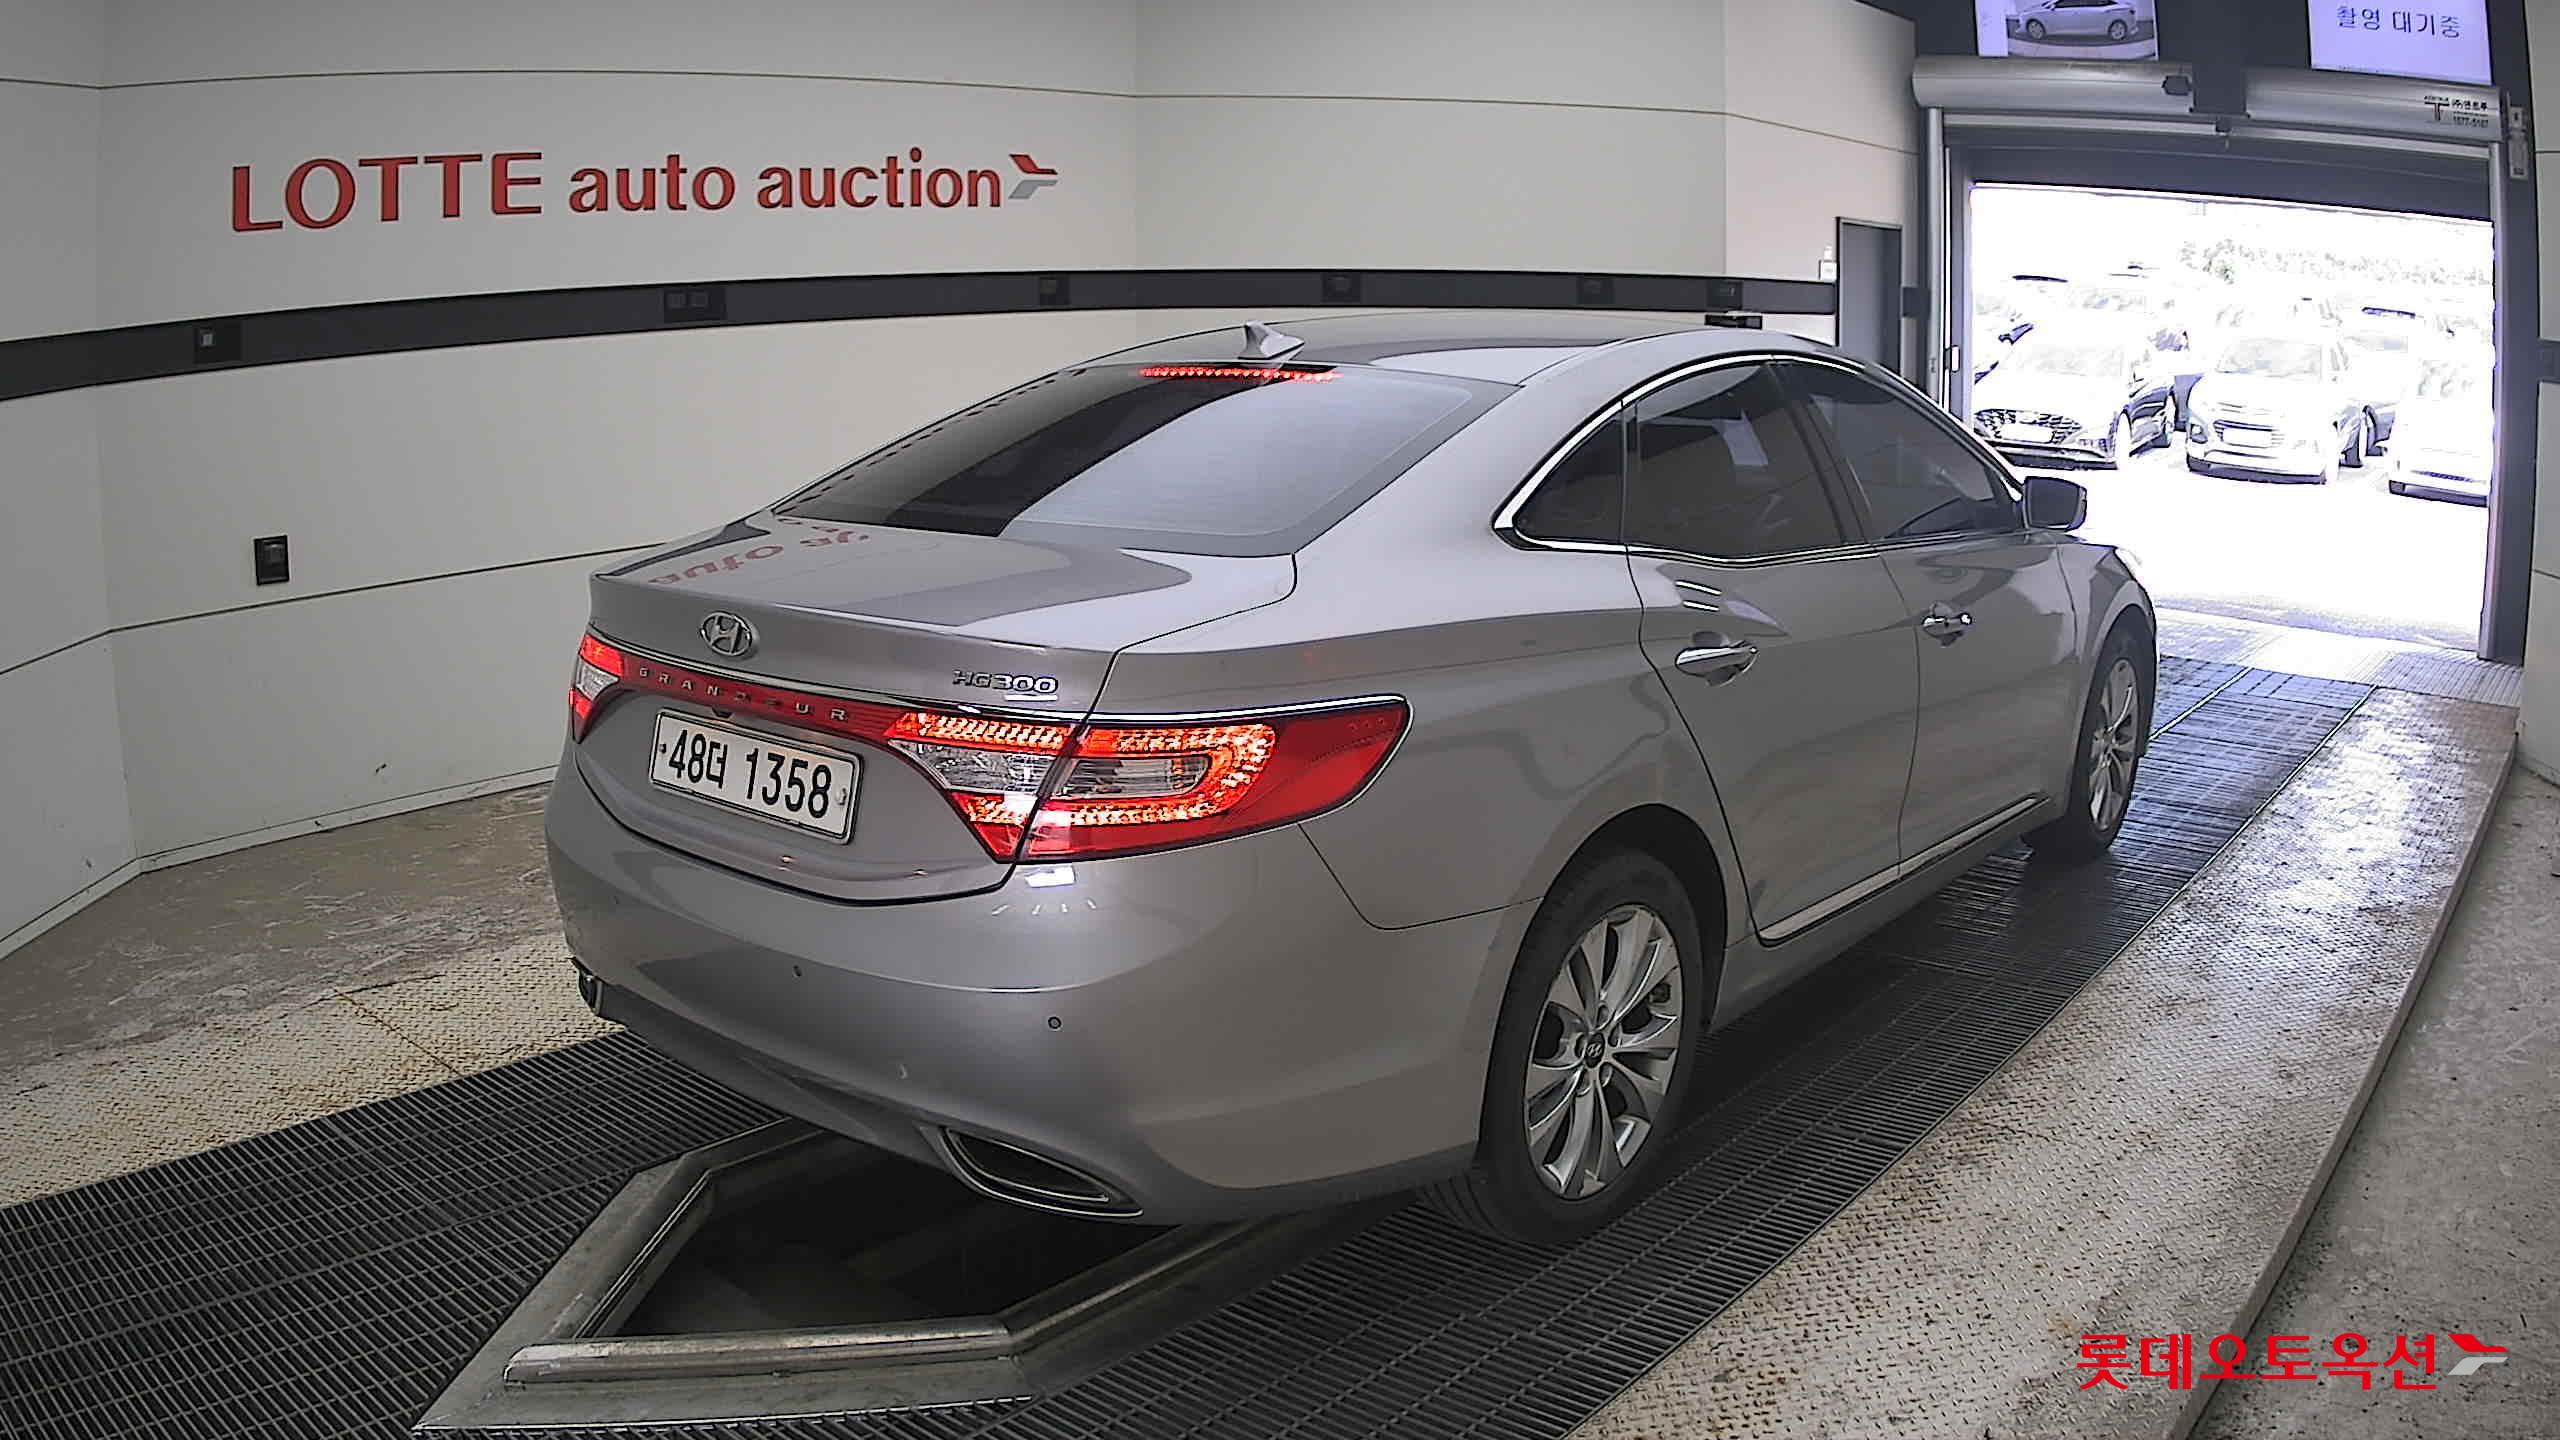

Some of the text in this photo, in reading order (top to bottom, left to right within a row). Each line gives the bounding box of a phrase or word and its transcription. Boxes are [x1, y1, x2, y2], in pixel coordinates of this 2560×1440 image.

[2337, 6, 2461, 39] 촬영 대기중
[232, 146, 1002, 232] LOTTE auto auction
[951, 670, 1059, 694] HG300
[668, 729, 832, 819] 48더 1358
